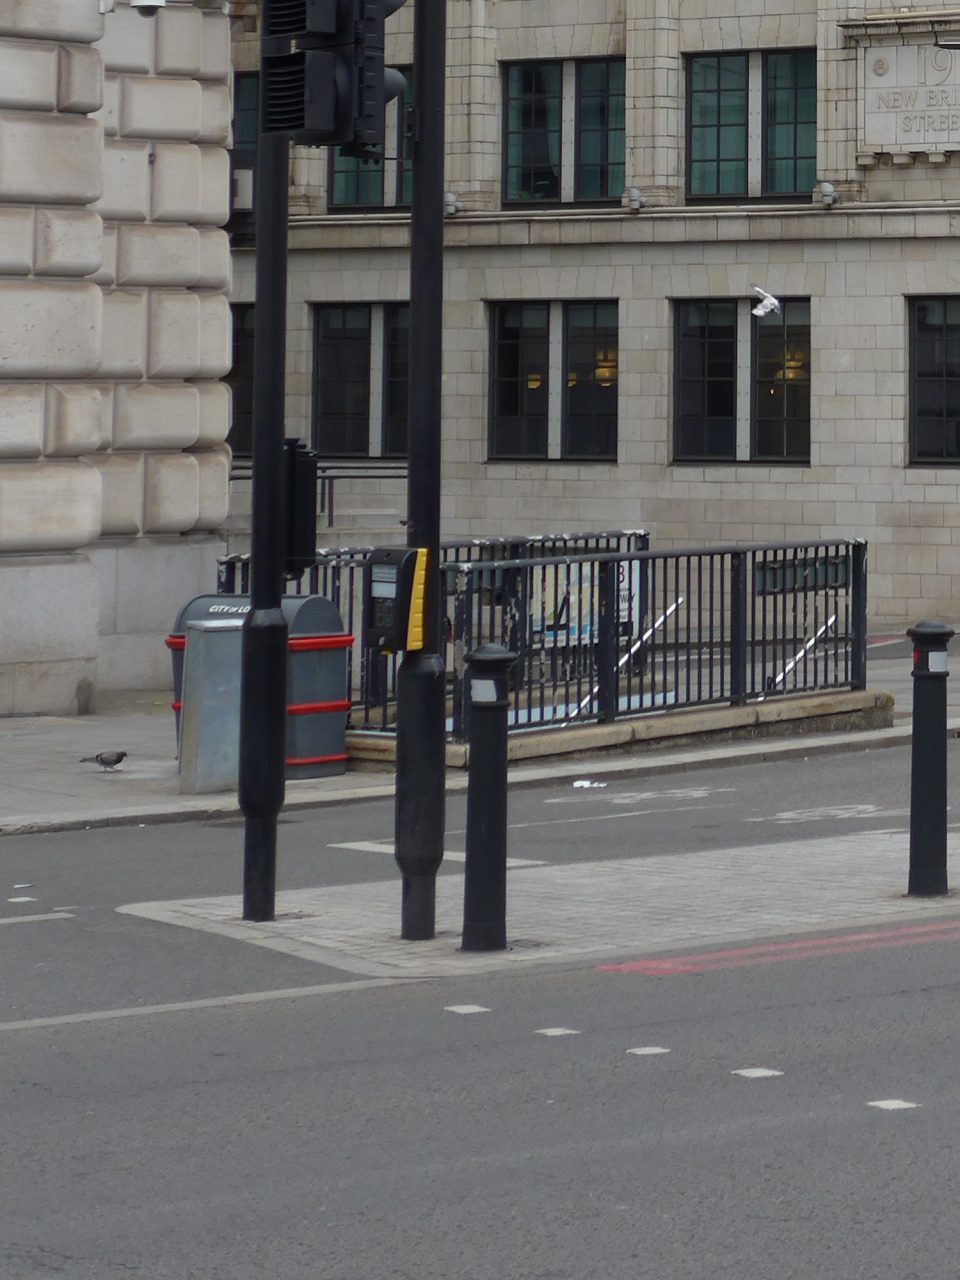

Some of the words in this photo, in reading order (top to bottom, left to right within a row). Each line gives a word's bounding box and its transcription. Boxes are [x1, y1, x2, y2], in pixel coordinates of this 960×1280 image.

[918, 47, 954, 86] 19
[876, 90, 918, 109] NEW
[209, 605, 230, 613] CITY
